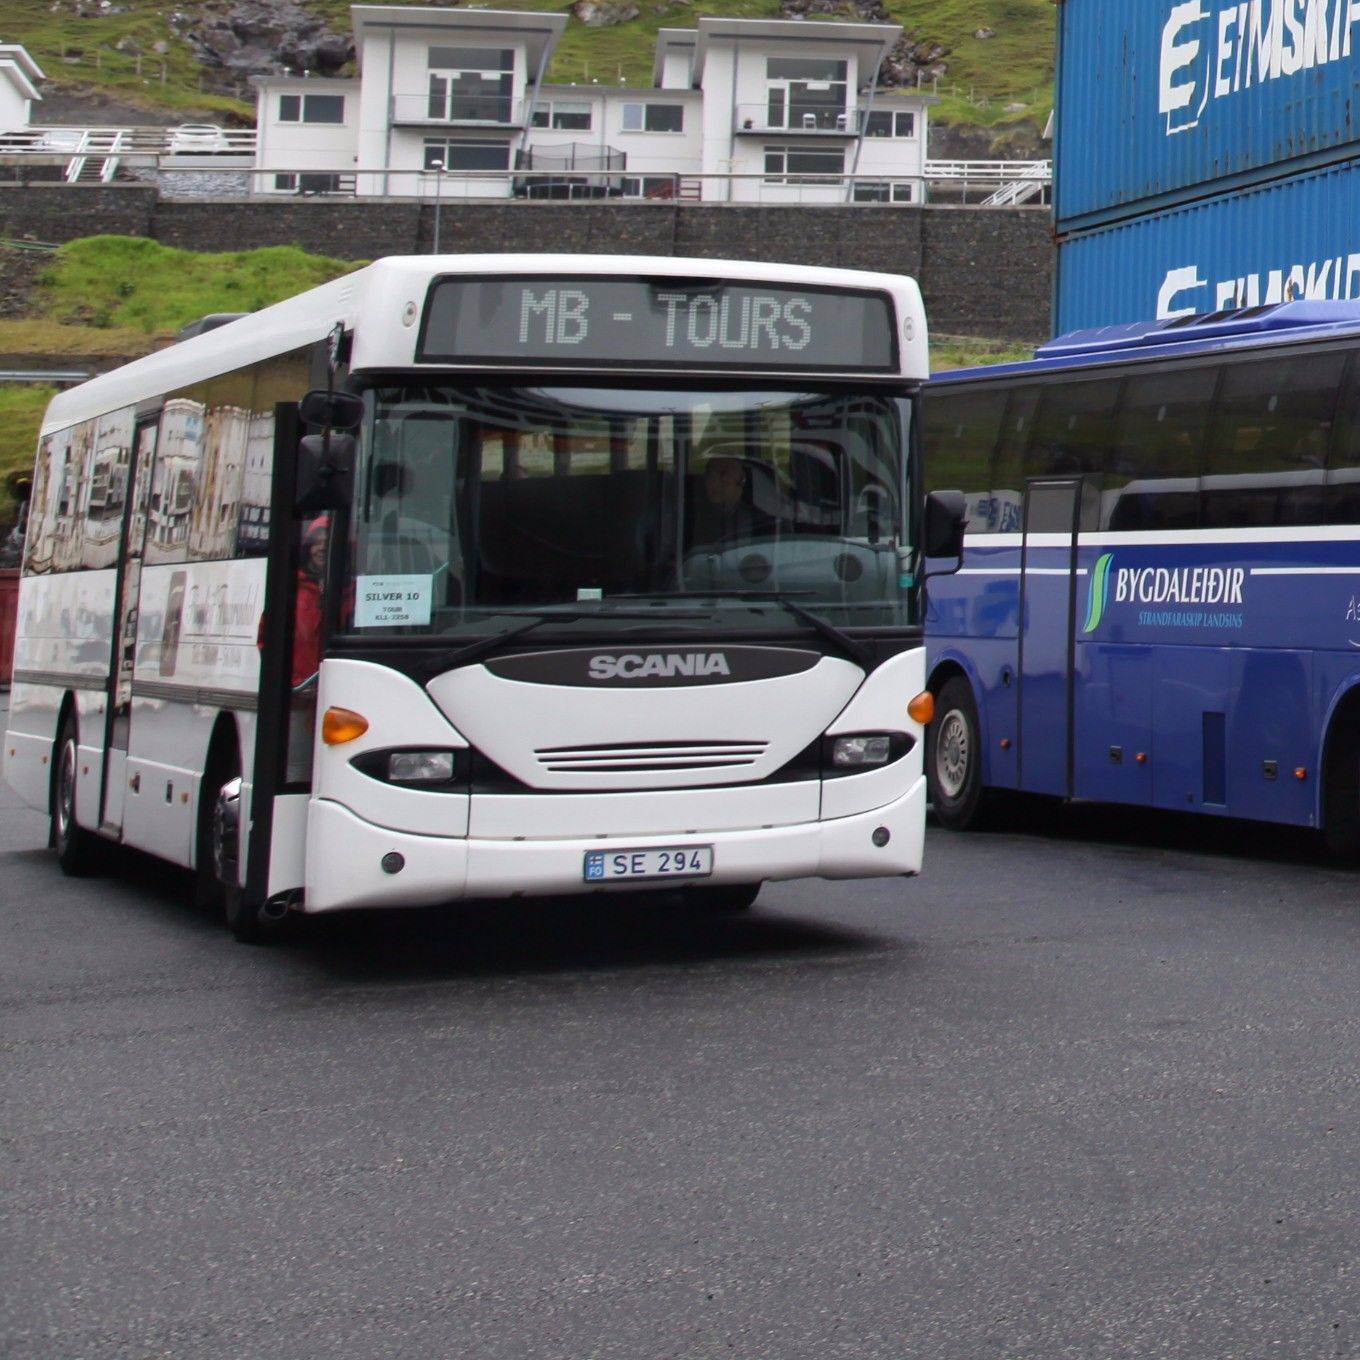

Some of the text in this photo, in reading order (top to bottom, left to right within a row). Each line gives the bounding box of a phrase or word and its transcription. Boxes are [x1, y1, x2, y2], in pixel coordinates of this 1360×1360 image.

[518, 288, 590, 344] MB
[657, 293, 813, 350] TOURS
[366, 592, 420, 601] SILVER 10
[1115, 567, 1245, 604] BYGDALEIÐIR
[1138, 612, 1243, 628] STRANDFARASKIP LANDSINS
[588, 652, 731, 680] SCANIA
[613, 853, 646, 875] SE
[658, 850, 701, 872] 294
